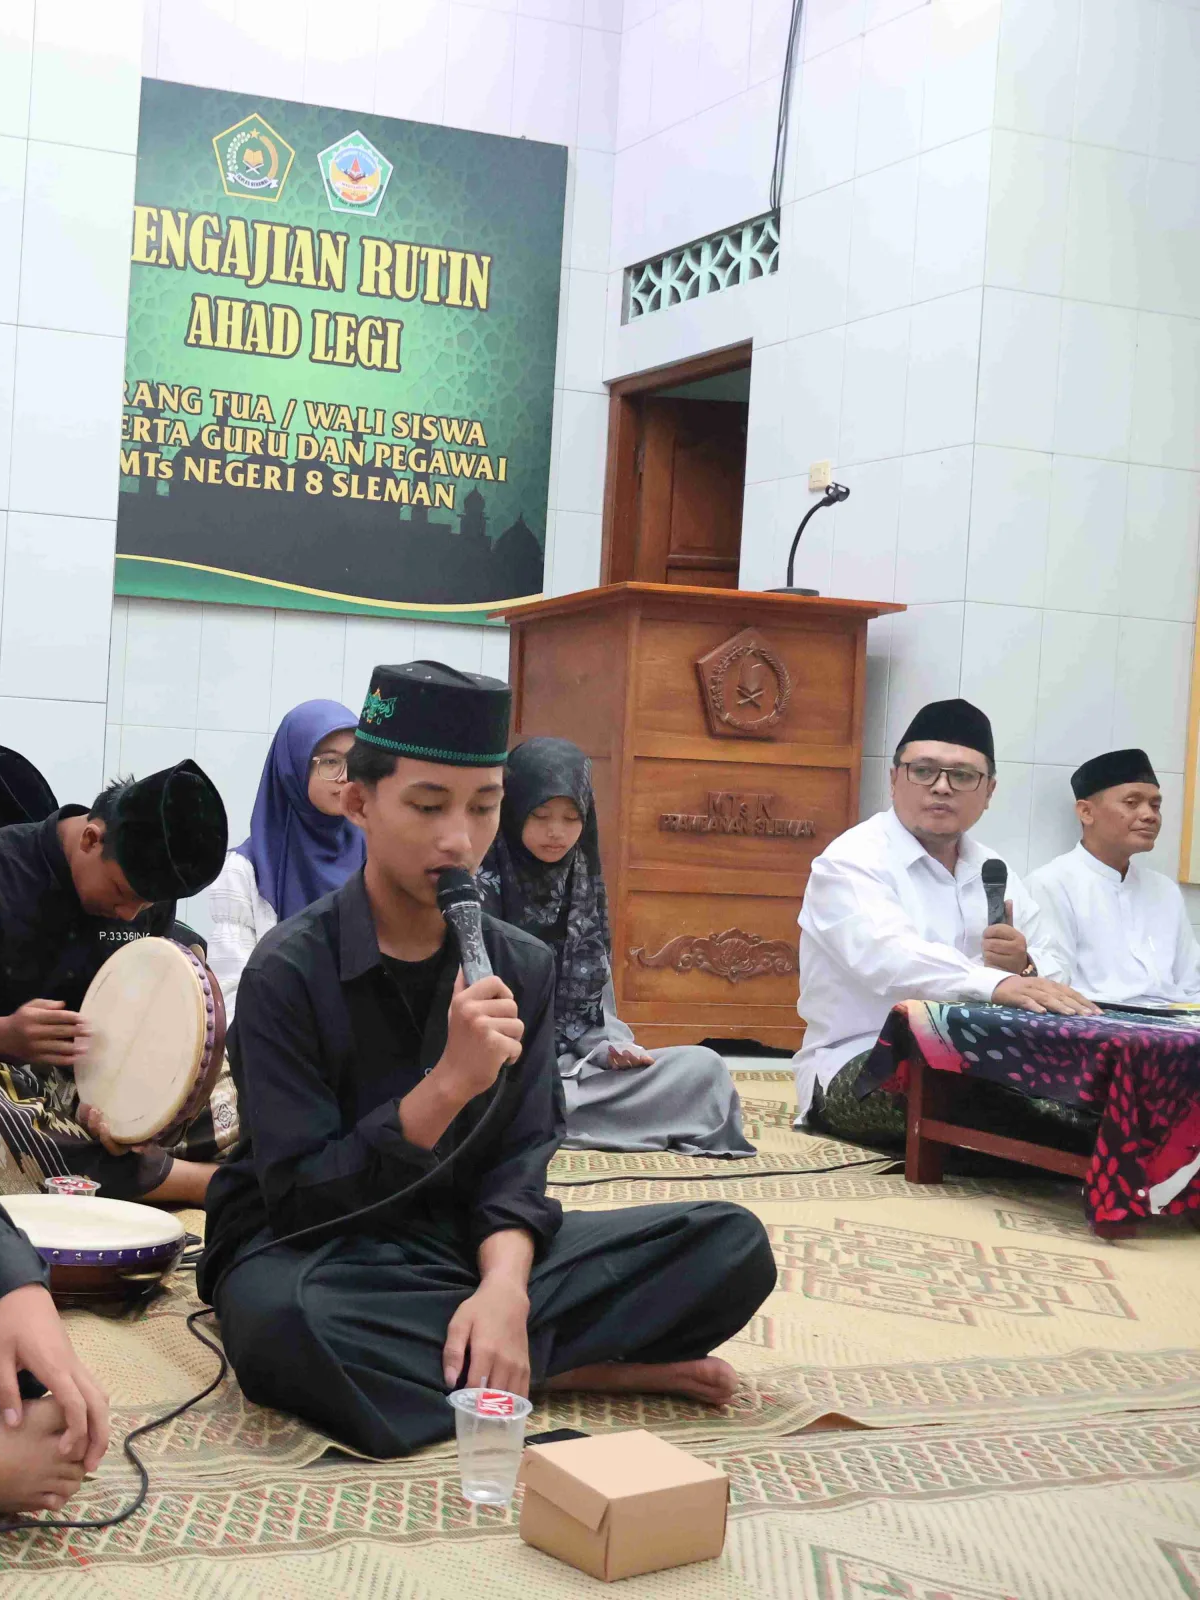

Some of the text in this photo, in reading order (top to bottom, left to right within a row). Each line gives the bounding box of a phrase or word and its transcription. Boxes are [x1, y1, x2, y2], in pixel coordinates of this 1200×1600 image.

[360, 237, 491, 309] RUTIN
[188, 296, 401, 370] AHAD LEGI
[211, 391, 275, 423] TUA
[282, 400, 296, 429] /
[305, 401, 385, 435] WALI
[393, 412, 487, 447] SISWA
[120, 450, 455, 509] MTs NEGERI 8 SLEMAN
[201, 424, 288, 459] GURU
[297, 434, 365, 466] DAN
[374, 443, 508, 482] PEGAWAI
